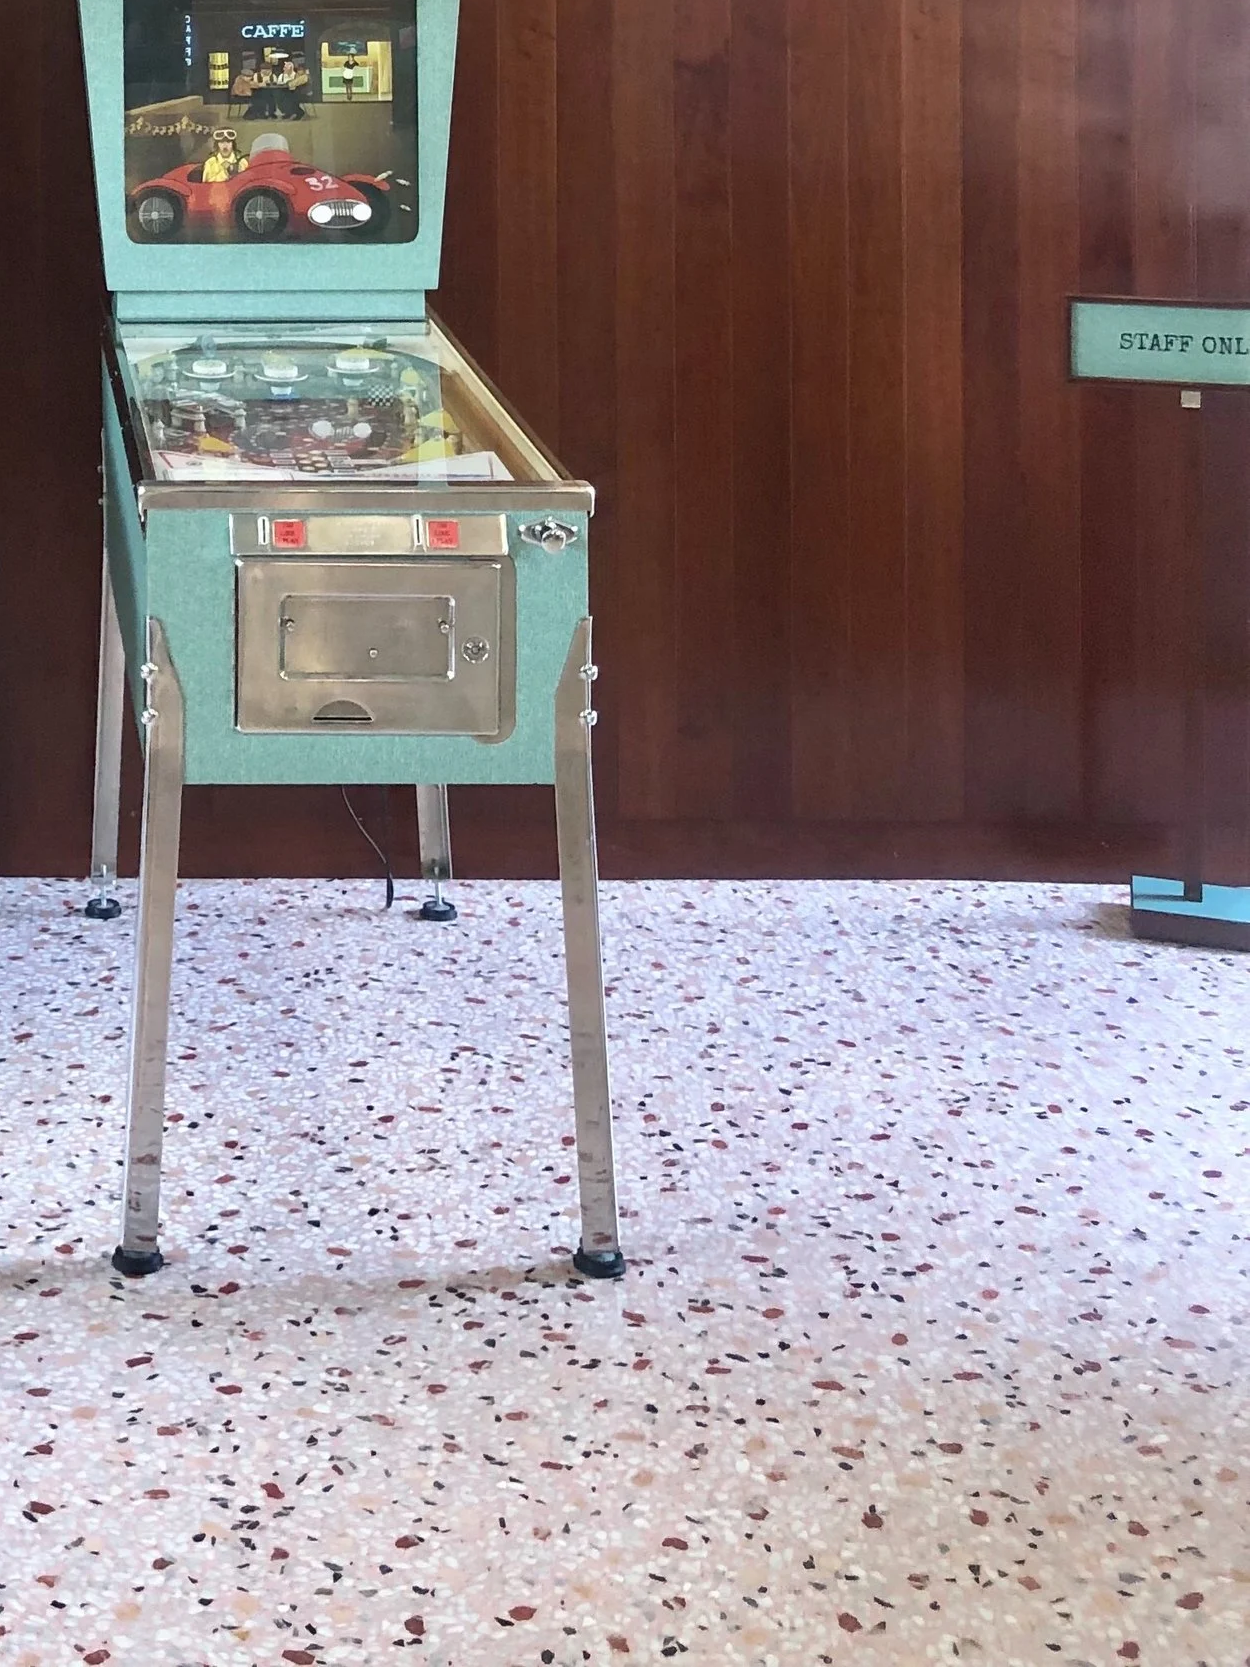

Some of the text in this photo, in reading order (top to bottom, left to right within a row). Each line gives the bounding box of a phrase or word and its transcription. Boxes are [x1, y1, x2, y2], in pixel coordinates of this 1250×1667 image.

[304, 176, 339, 191] 32
[1119, 333, 1250, 355] STAFF ONL
